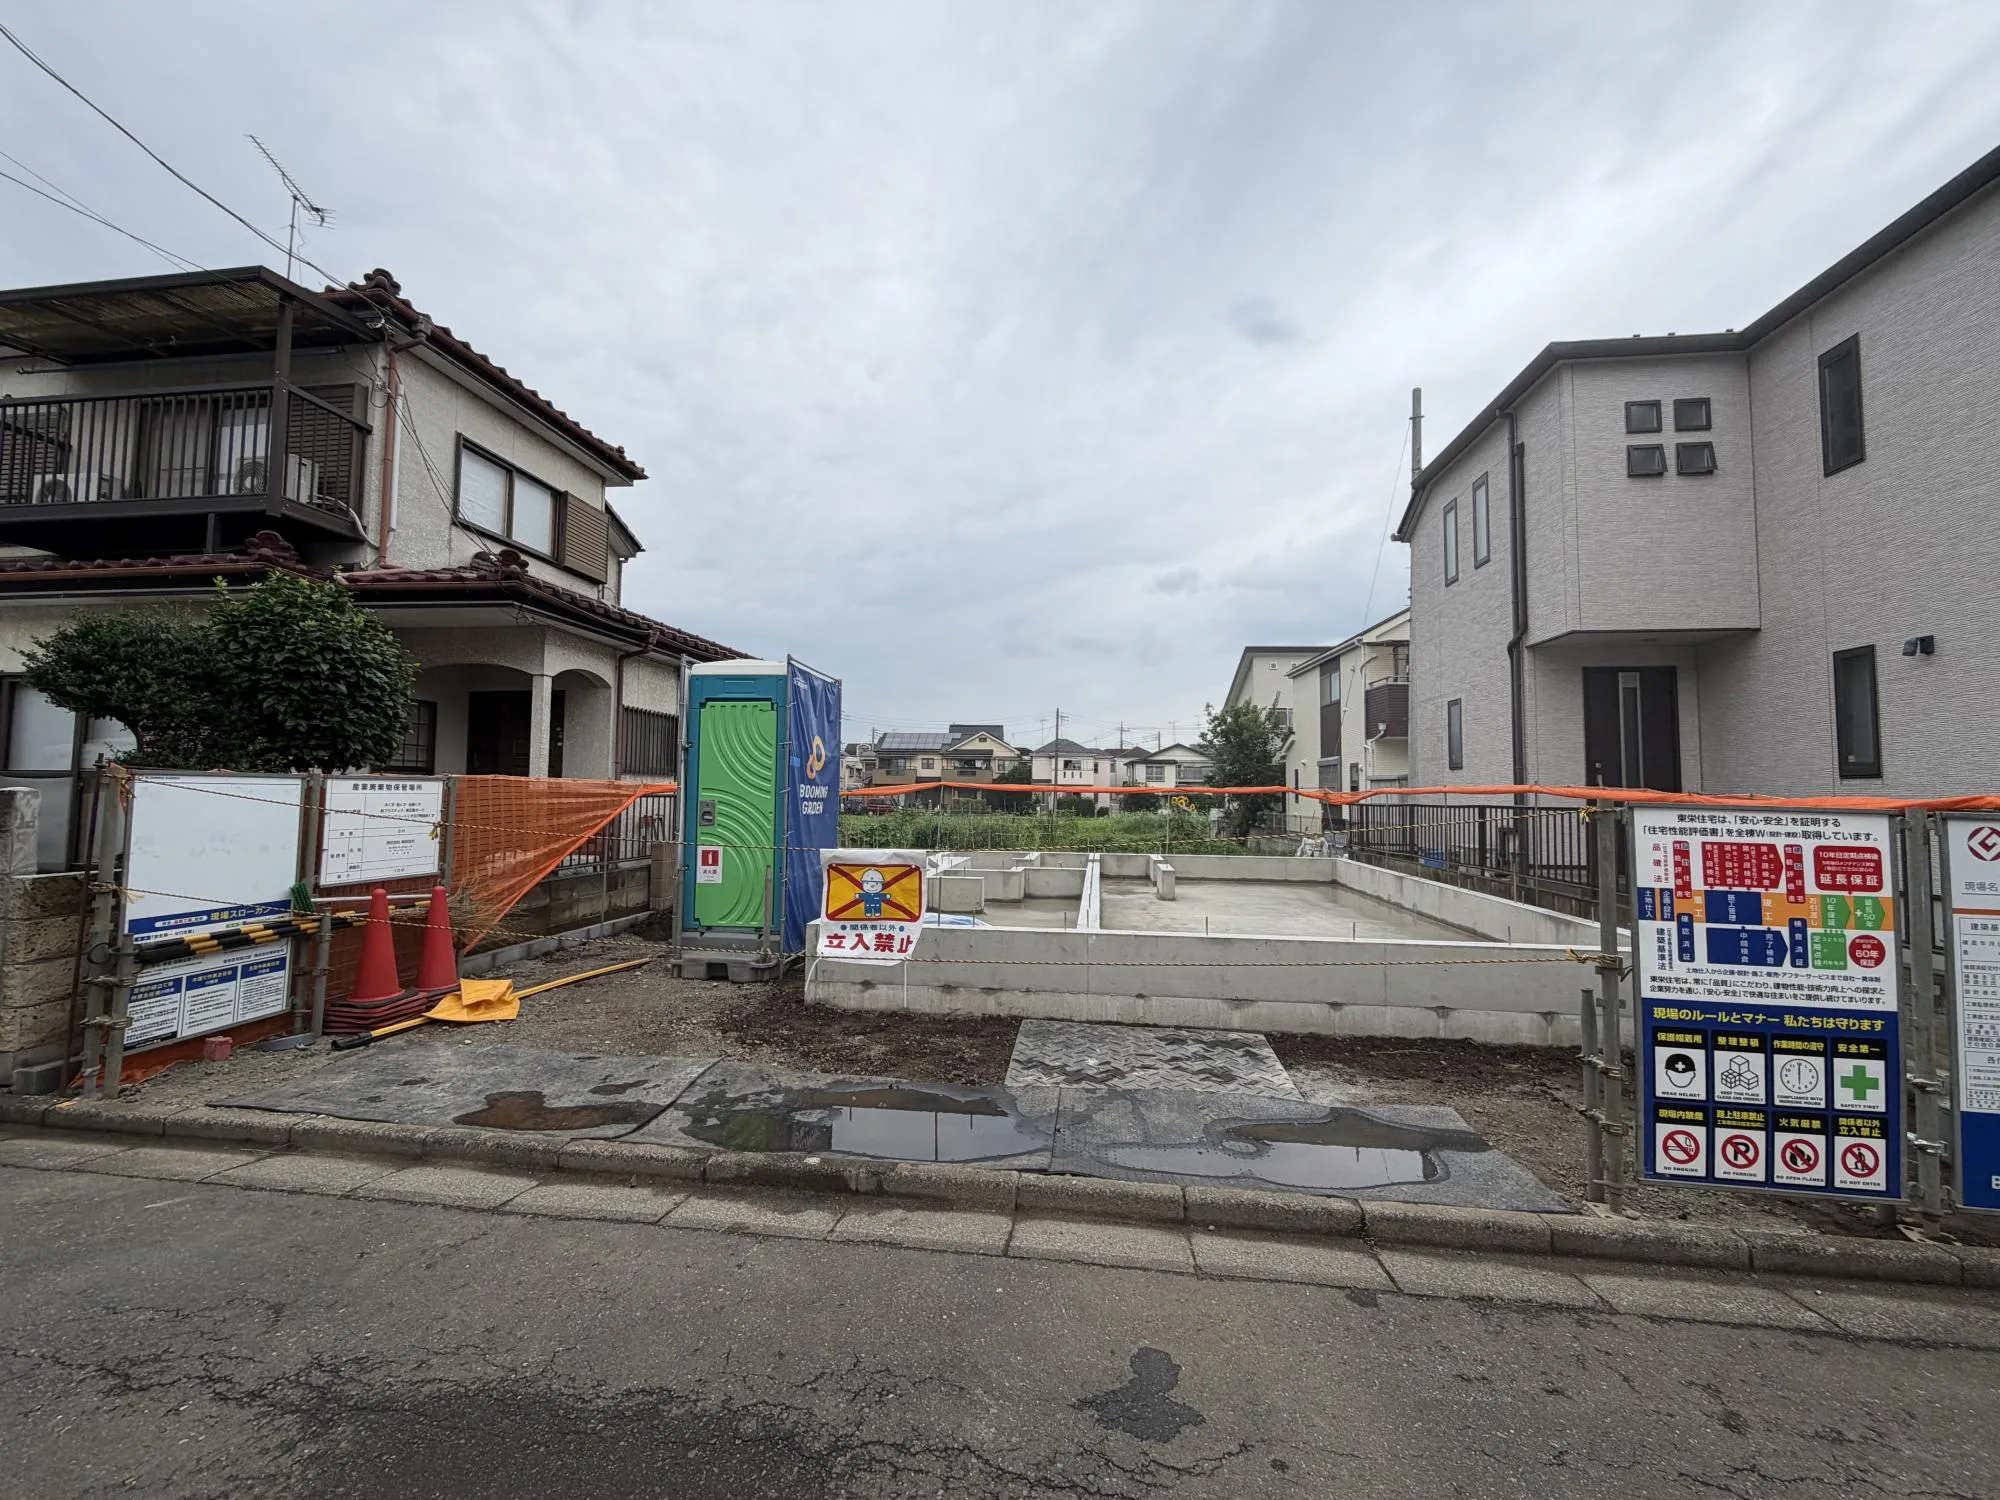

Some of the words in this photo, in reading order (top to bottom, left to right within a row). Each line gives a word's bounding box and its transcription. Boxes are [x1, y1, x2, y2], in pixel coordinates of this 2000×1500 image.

[351, 783, 423, 792] 産業廃棄物保管場所
[802, 801, 824, 815] GRDEN
[1820, 873, 1879, 887] 延長保証
[1964, 881, 1998, 892] 現場名
[1644, 889, 1654, 918] 土地仕入
[1826, 897, 1837, 927] 10年保証
[849, 924, 897, 932] 関係者以外
[824, 933, 914, 954] 立入禁止
[1680, 915, 1691, 961] 確認済証
[1793, 920, 1804, 966] 検査済証
[1656, 927, 1667, 971] 建築基準法
[1739, 932, 1749, 963] 中間検査
[1765, 933, 1775, 965] 完了検査
[1855, 949, 1880, 959] 60年
[1653, 1007, 1780, 1024] 現場のルールとマナー
[1783, 1014, 1885, 1031] 私たちは守ります
[1657, 1032, 1703, 1044] 保護帽着用
[1717, 1036, 1759, 1047] 整理整頓
[1773, 1040, 1825, 1051] 作業時間の遵守
[1837, 1043, 1881, 1054] 安全第一
[1658, 1108, 1704, 1120] 現場内禁煙
[1716, 1109, 1765, 1121] 路上駐車禁止
[1779, 1118, 1821, 1129] 火気厳禁
[1838, 1117, 1881, 1127] 関係者以外
[1838, 1126, 1881, 1137] 立入禁止
